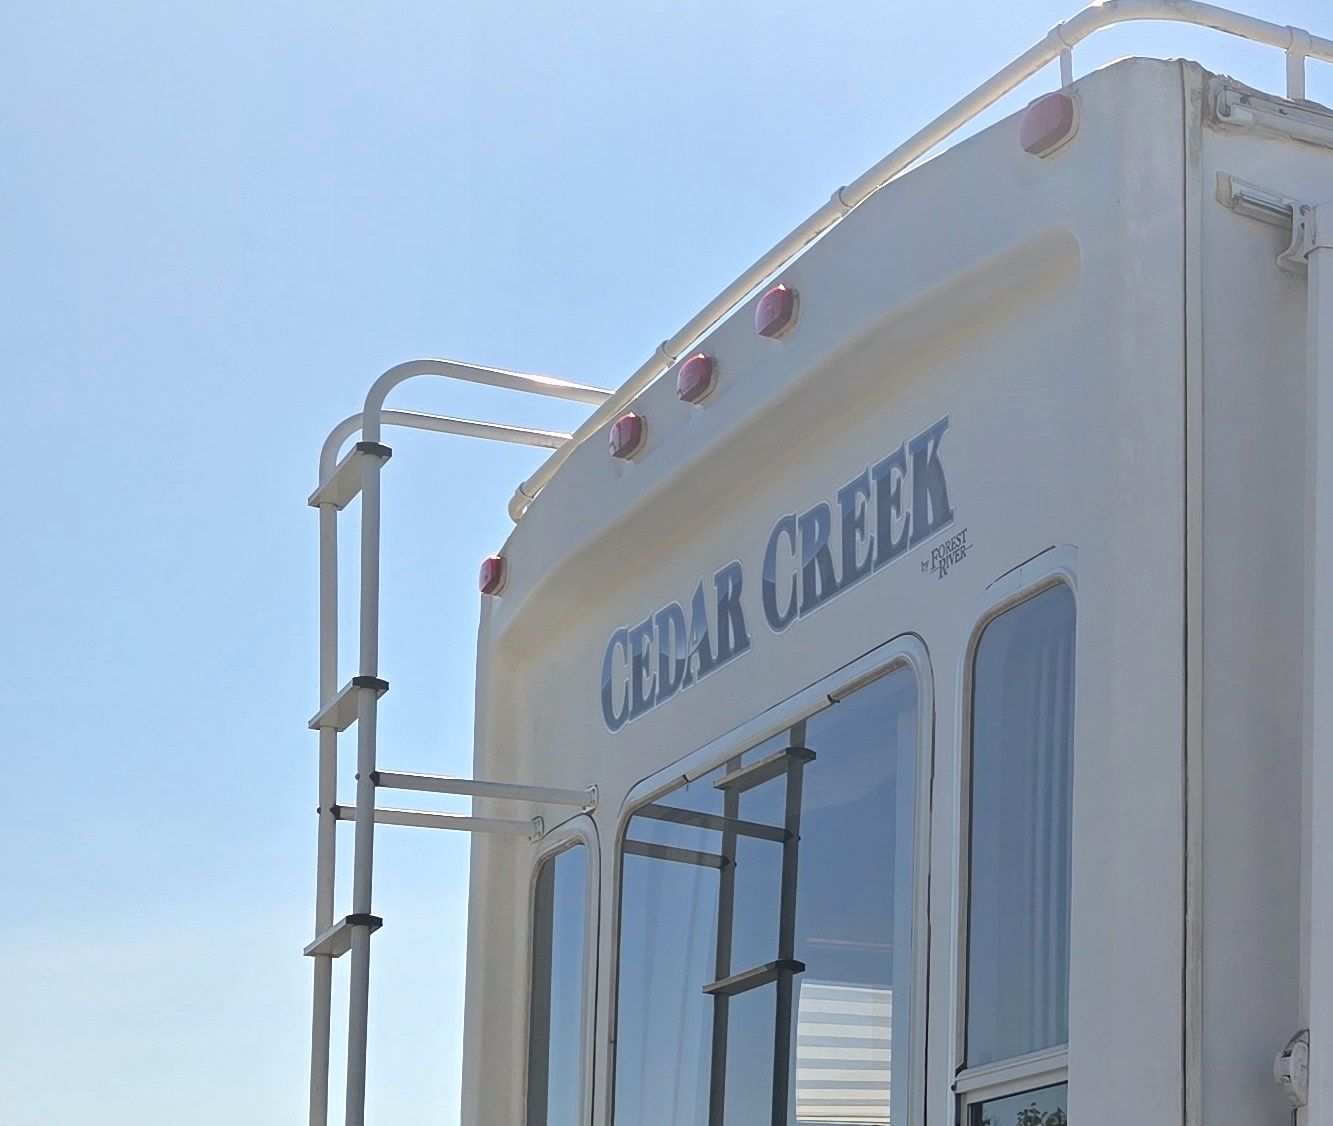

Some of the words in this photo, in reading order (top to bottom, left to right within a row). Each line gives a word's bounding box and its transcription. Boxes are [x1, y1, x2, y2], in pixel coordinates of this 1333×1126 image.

[931, 528, 967, 570] FOREST
[935, 545, 970, 579] RIVER
[601, 560, 752, 734] CEDAR
[762, 413, 956, 635] CREEK
